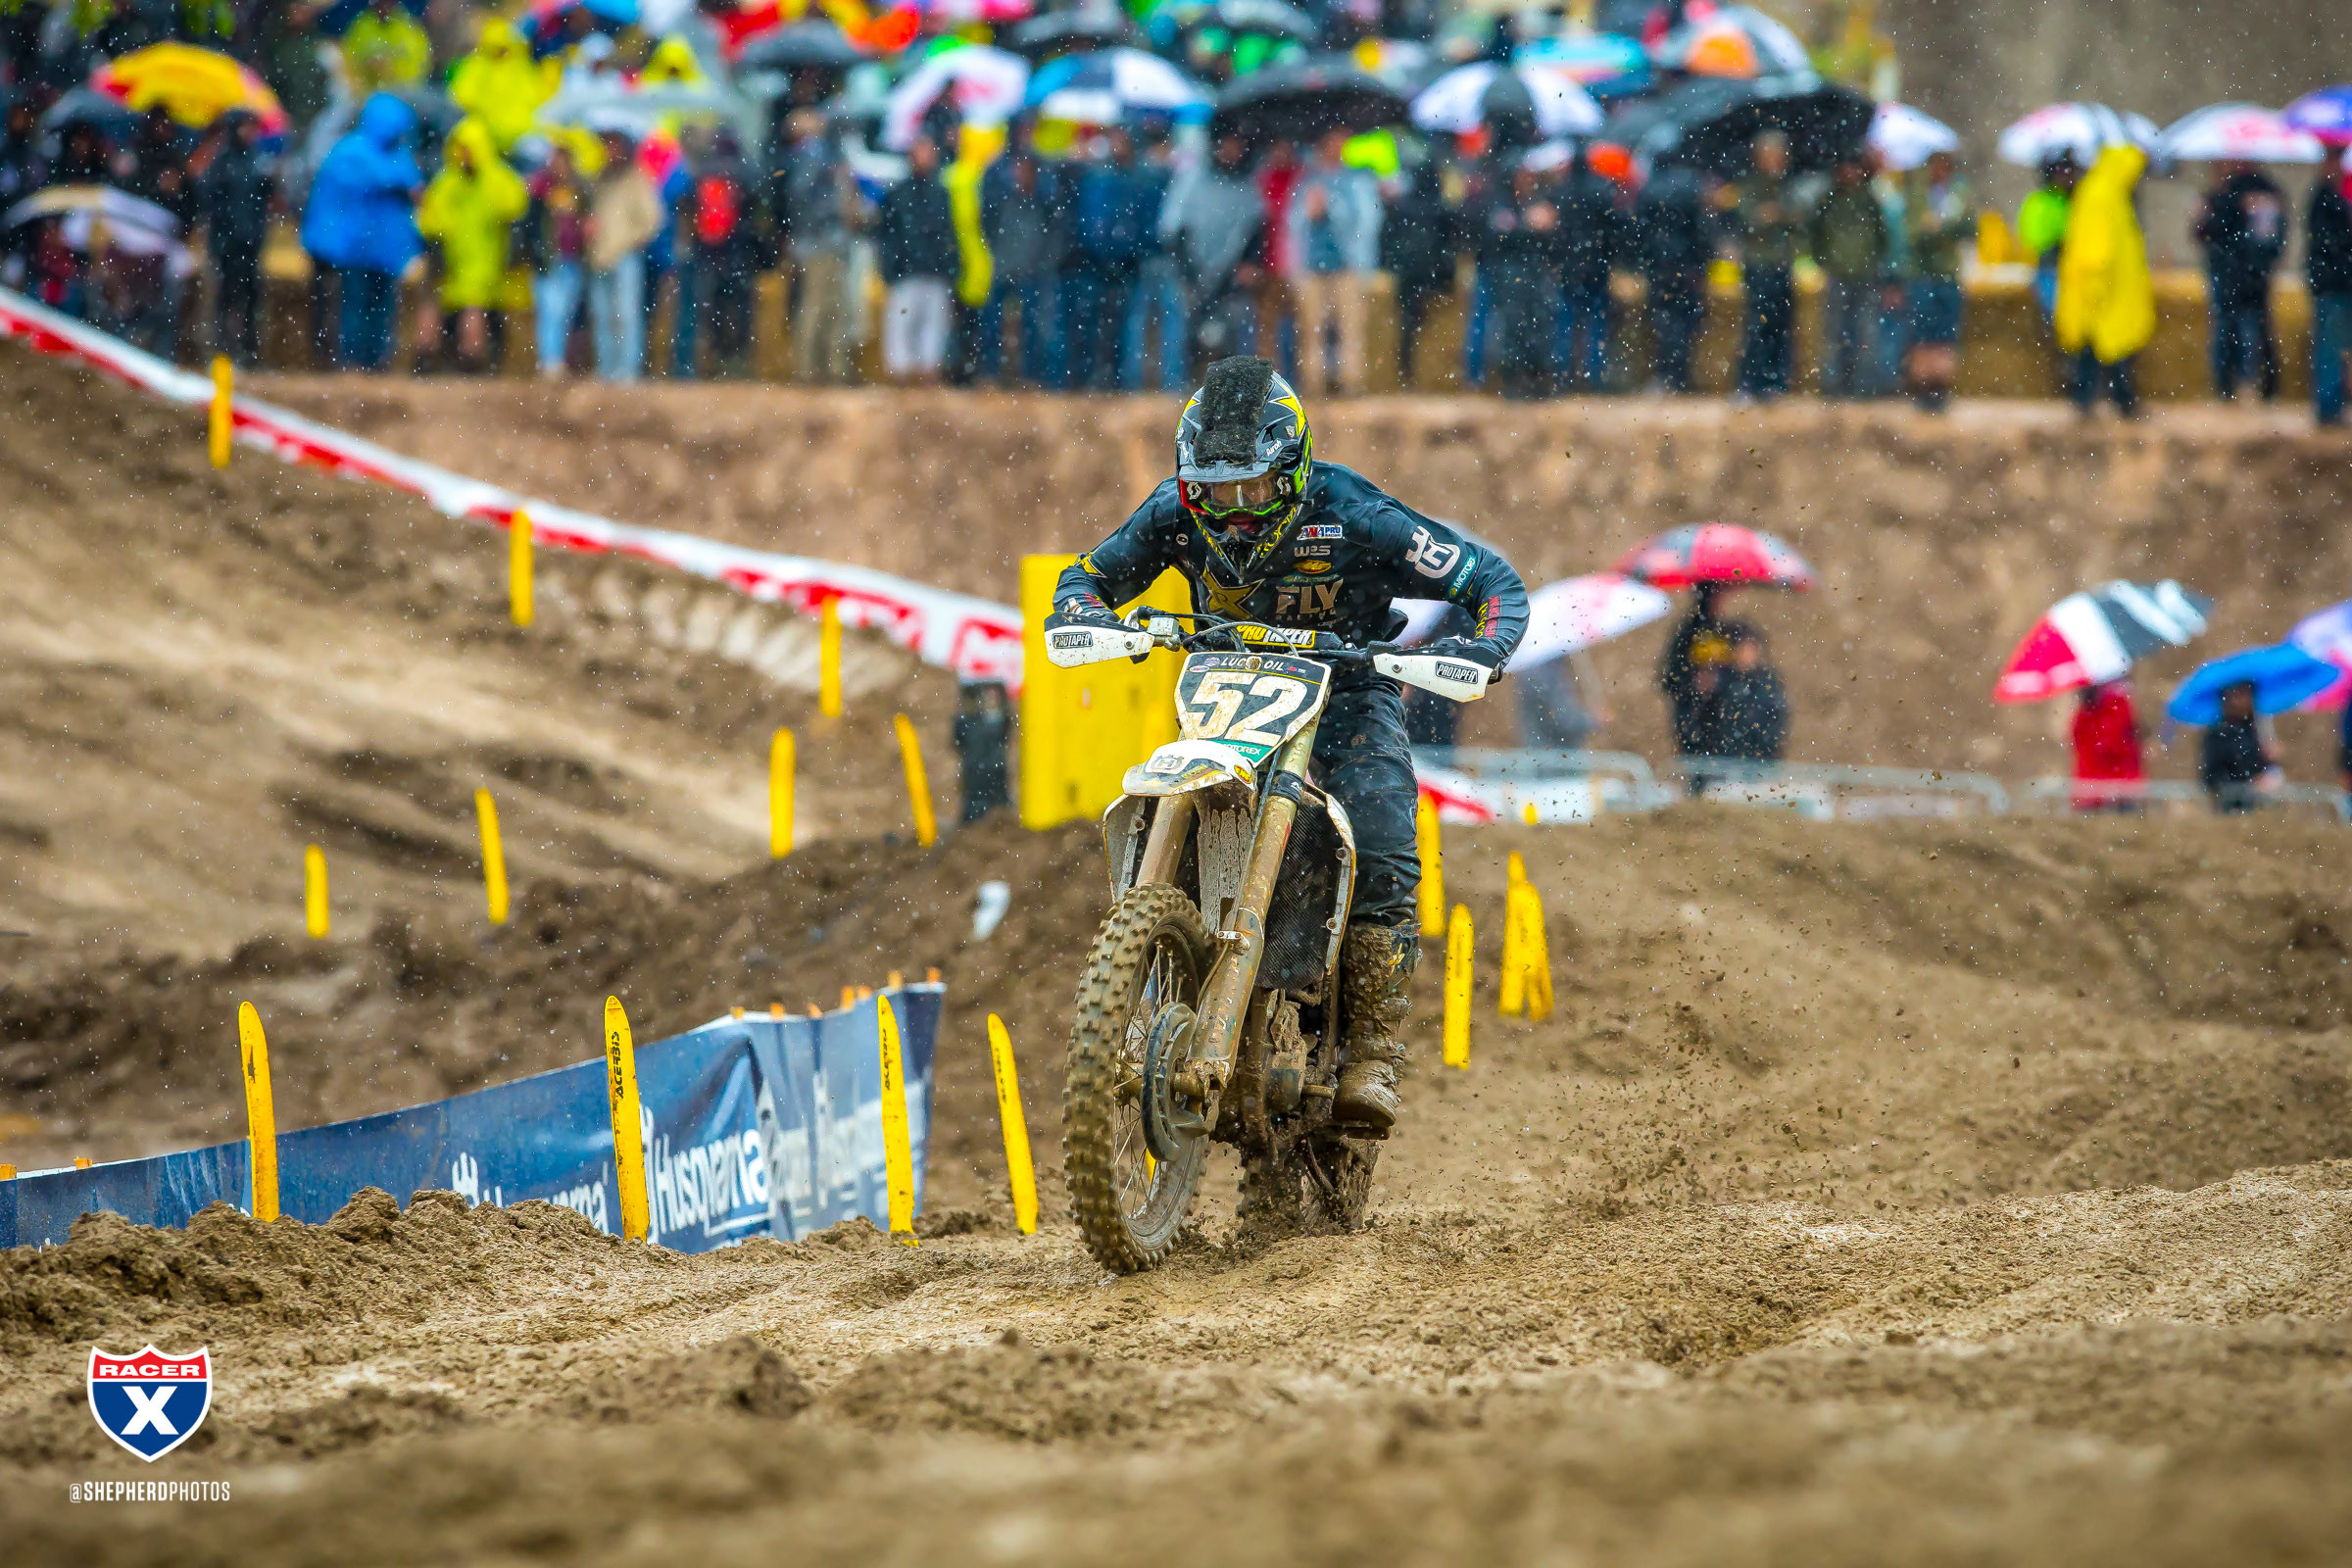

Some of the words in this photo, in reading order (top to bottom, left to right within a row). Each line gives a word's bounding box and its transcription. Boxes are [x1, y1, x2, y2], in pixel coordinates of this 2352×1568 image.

[1276, 577, 1344, 614] FLY
[1054, 633, 1091, 648] PROTAPER
[1263, 661, 1286, 671] OIL
[1438, 663, 1477, 682] PROTAPER
[1187, 671, 1308, 748] 52
[613, 1031, 624, 1099] ACERBIS
